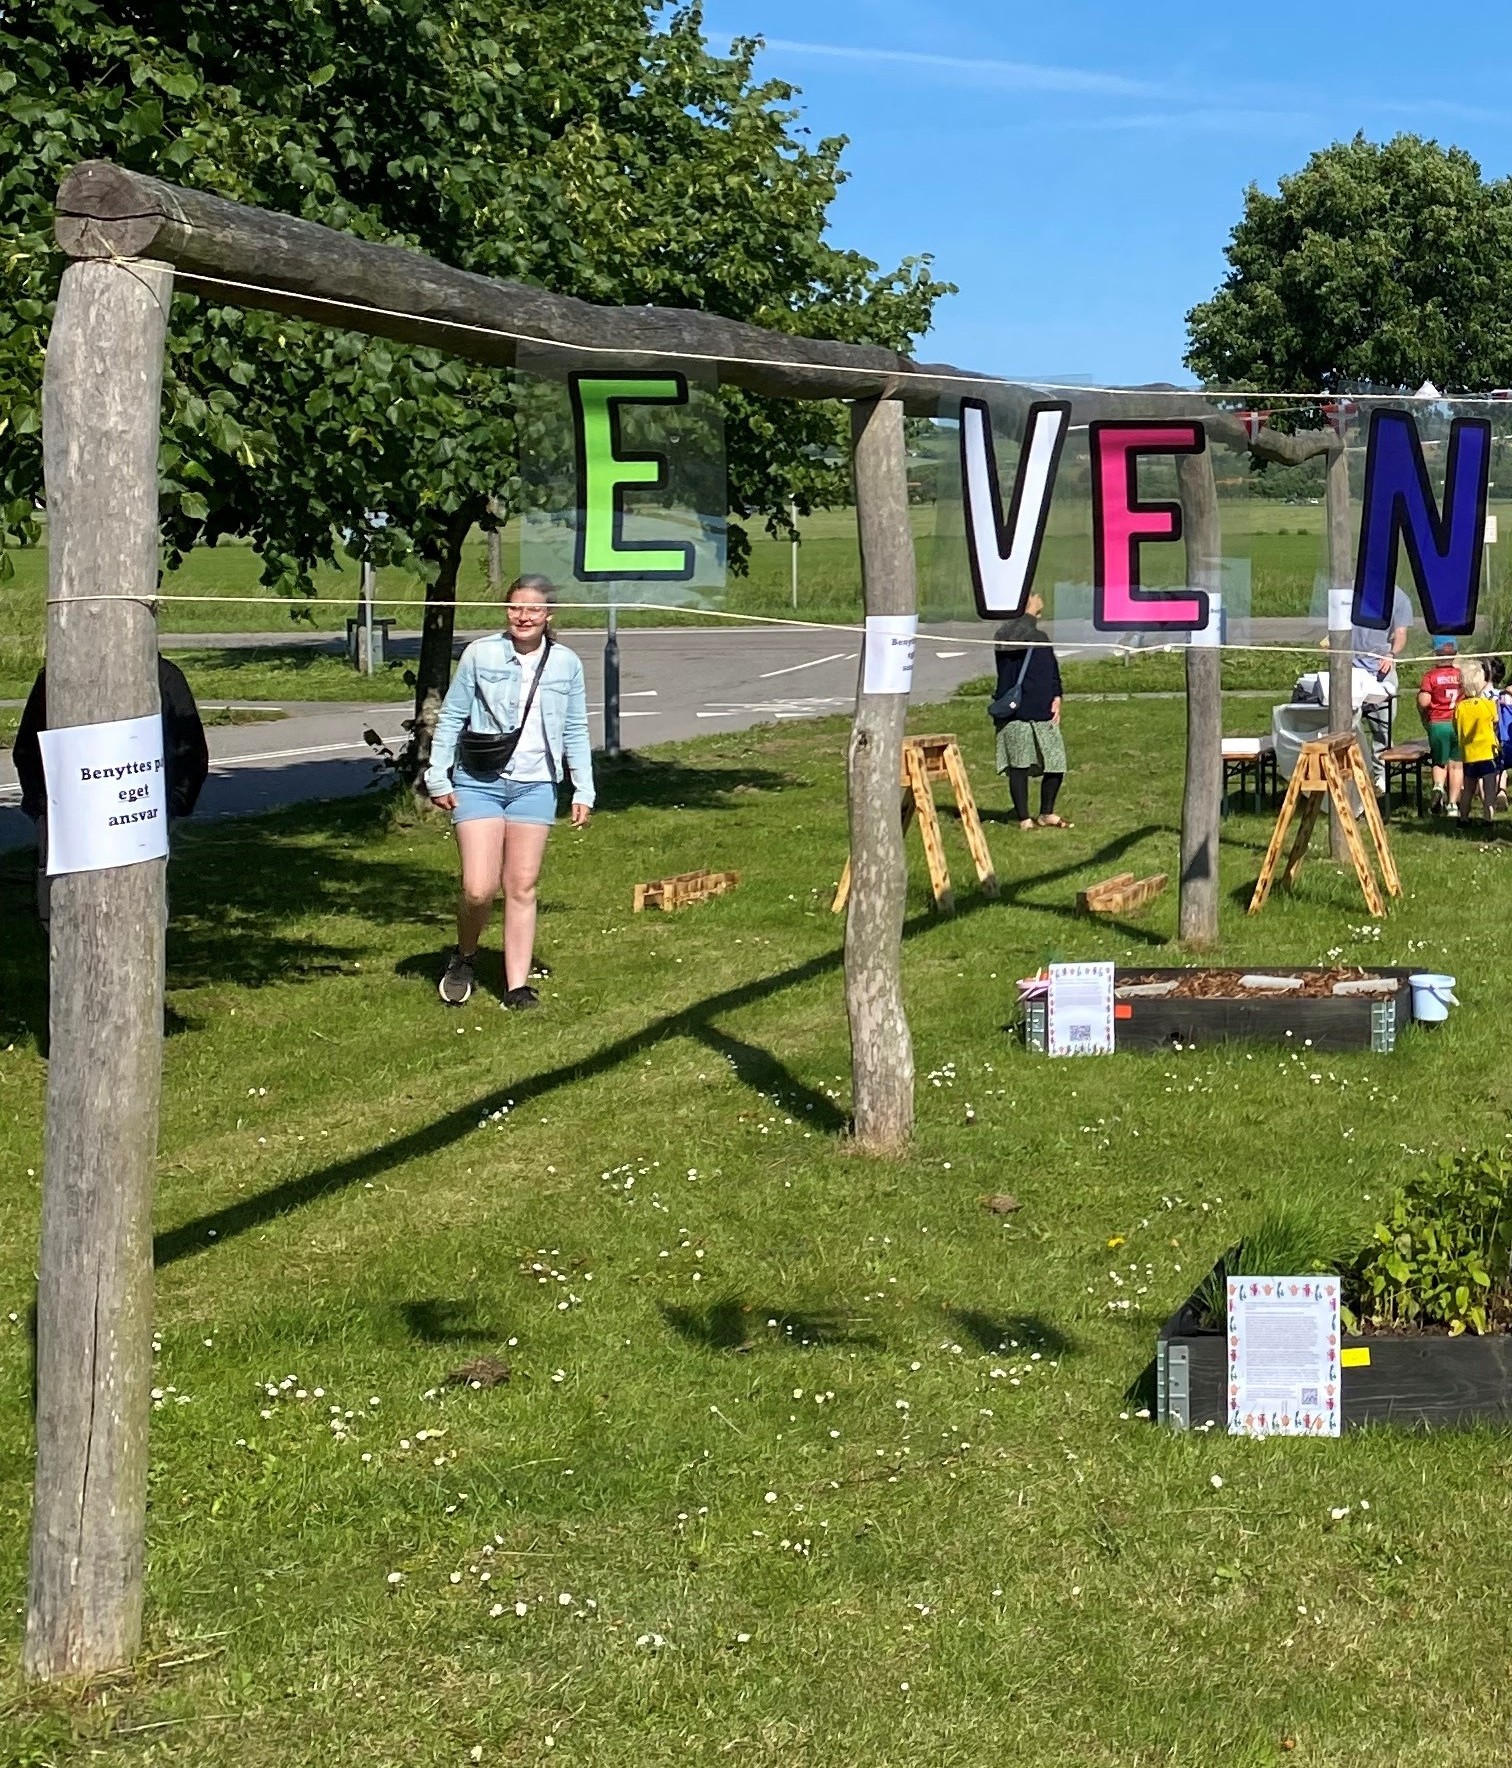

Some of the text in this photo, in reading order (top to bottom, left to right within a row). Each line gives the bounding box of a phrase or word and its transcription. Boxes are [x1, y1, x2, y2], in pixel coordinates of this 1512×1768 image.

[1445, 688, 1458, 709] 7
[81, 760, 152, 781] Benyttes
[118, 784, 150, 803] eget
[108, 808, 158, 827] ansvar
